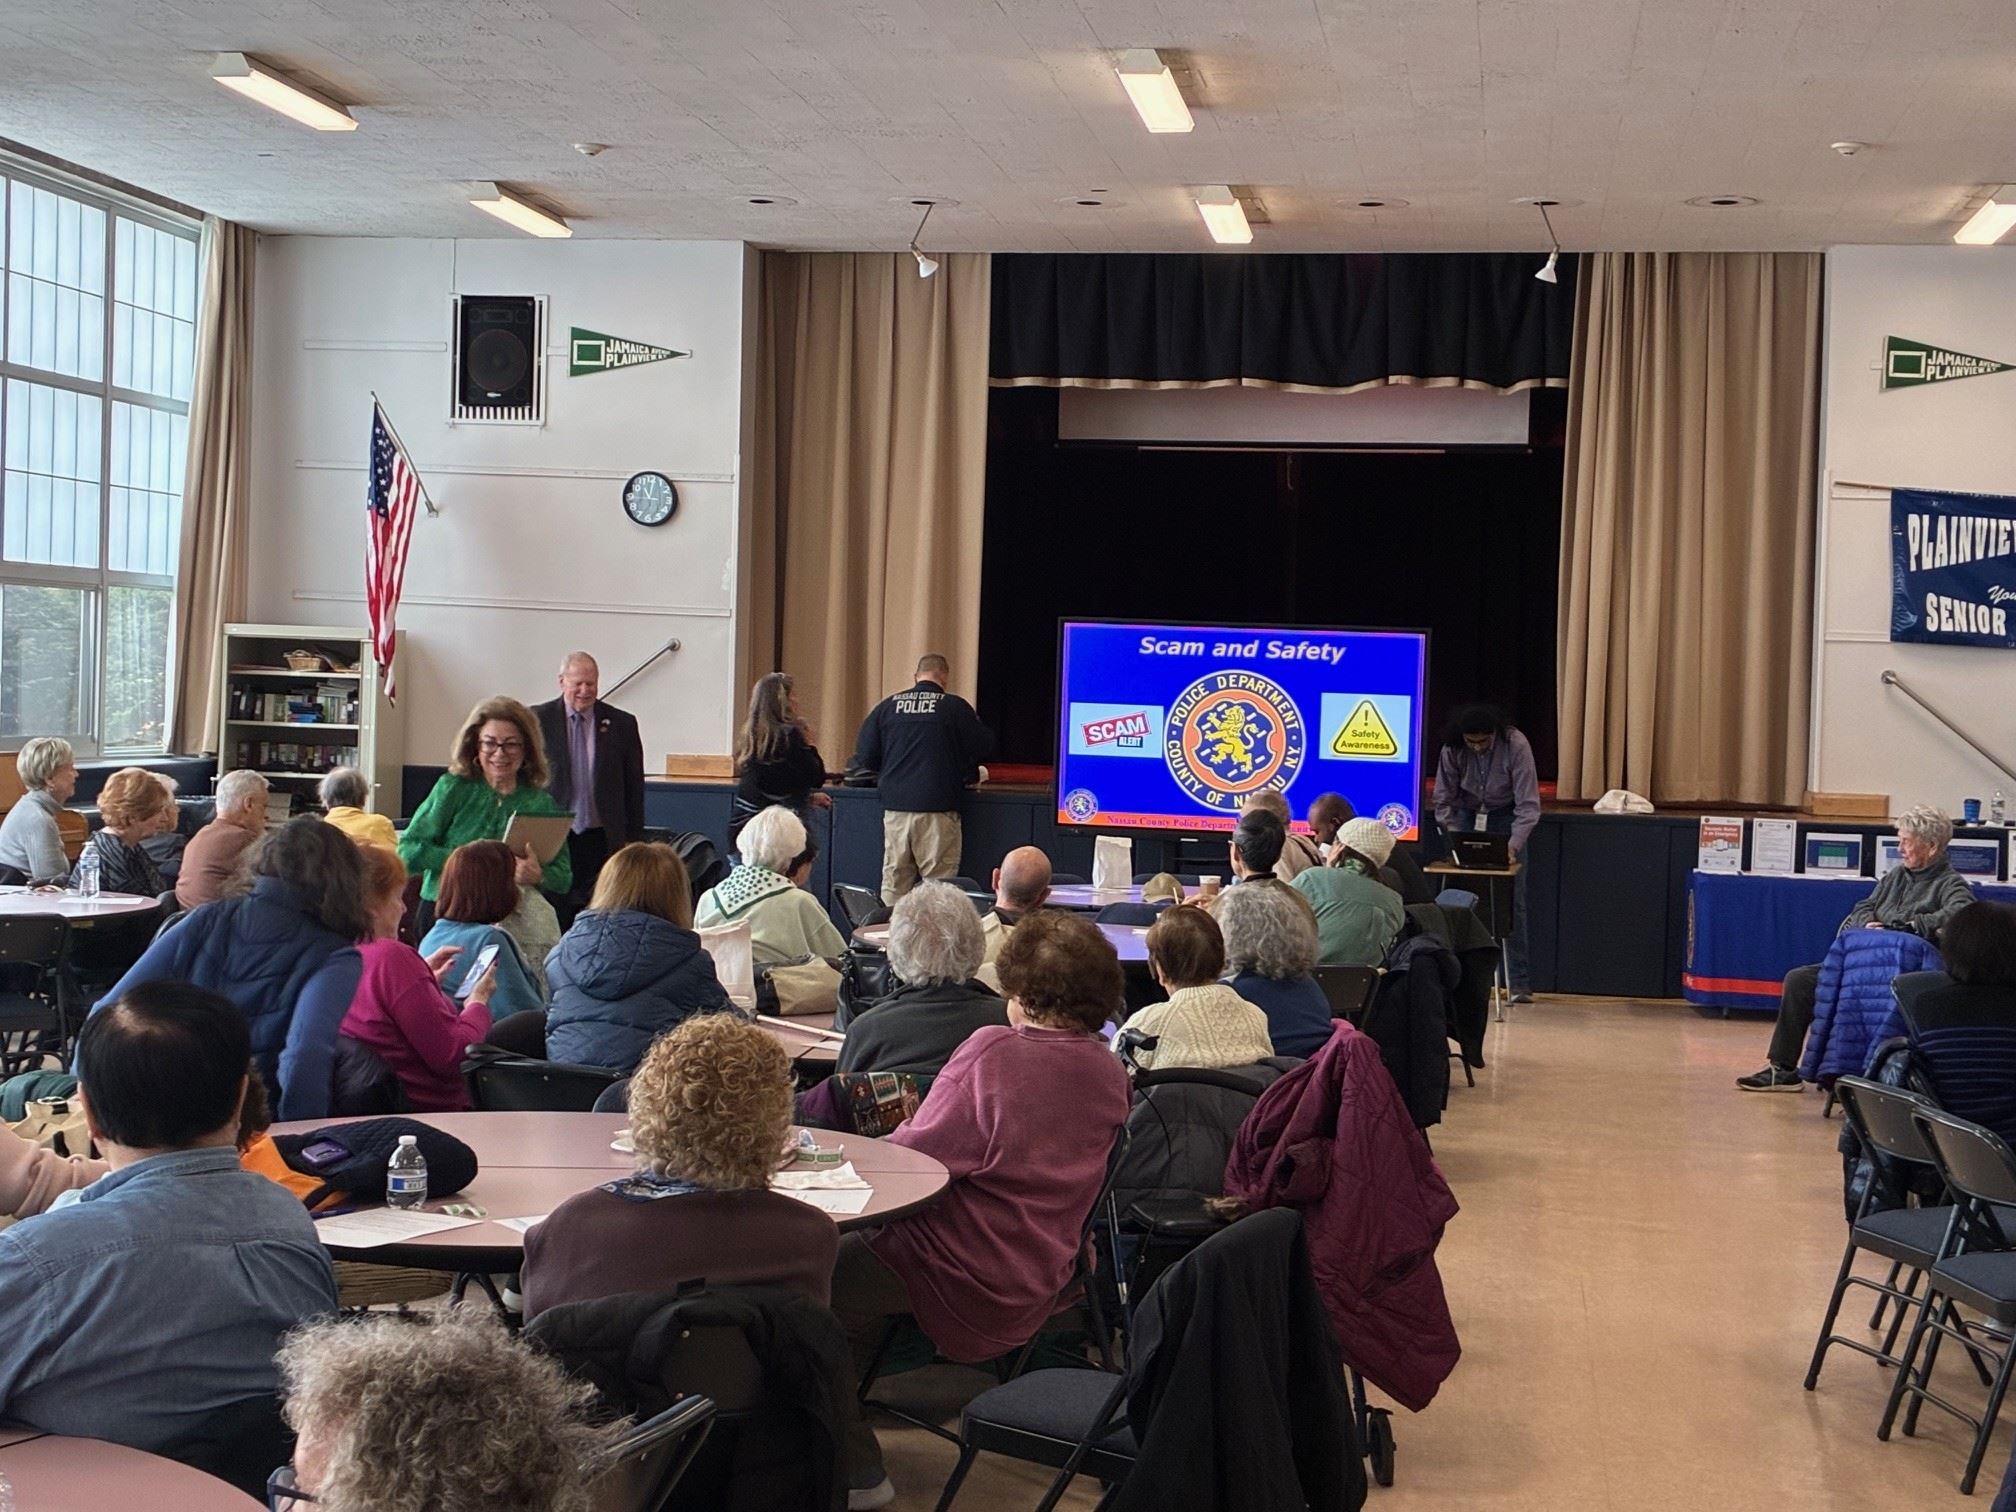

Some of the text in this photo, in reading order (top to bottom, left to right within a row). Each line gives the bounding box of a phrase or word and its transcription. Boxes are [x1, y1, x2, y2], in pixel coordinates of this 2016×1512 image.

[606, 339, 650, 354] JAMAICA
[605, 353, 657, 368] PLAINVIEW
[1927, 350, 1977, 366] JAMAICA
[1926, 365, 1985, 381] PLAINVIEW
[1907, 513, 2016, 572] PLAINVIE
[1926, 592, 2007, 636] SENIOR
[1139, 636, 1346, 665] Scam and Safety
[919, 691, 945, 700] COUNTY
[1171, 674, 1299, 729] POLICE DEPARTMENT
[896, 700, 937, 713] POLICE
[1088, 716, 1146, 742] SCAM
[1351, 730, 1380, 740] Safety
[1340, 740, 1390, 750] Awareness
[1168, 740, 1203, 793] COUNTY
[1206, 790, 1225, 805] OF
[1107, 815, 1238, 831] Nassau County Police Departm
